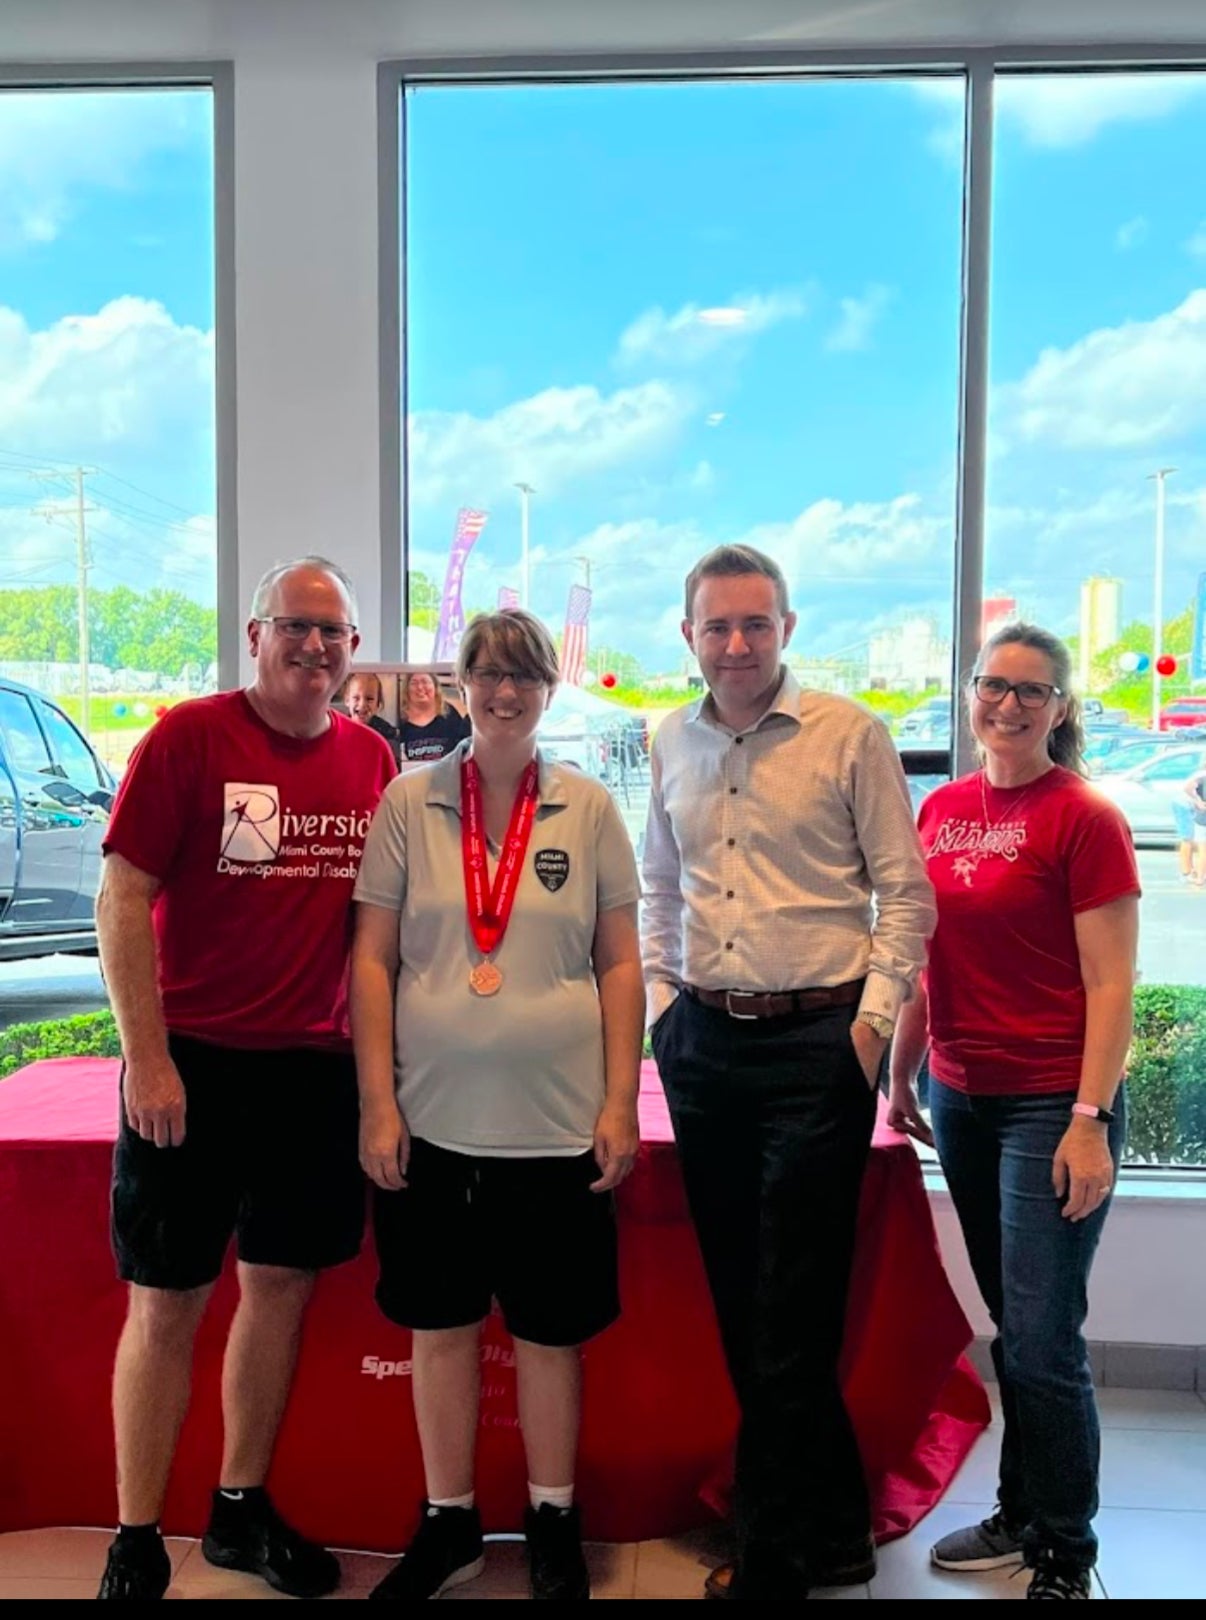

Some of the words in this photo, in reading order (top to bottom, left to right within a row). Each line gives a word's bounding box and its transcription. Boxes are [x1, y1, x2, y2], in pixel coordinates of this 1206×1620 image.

[279, 844, 308, 857] Miami
[310, 844, 345, 859] County
[217, 858, 320, 879] Devopmental
[536, 862, 567, 871] COUNTY
